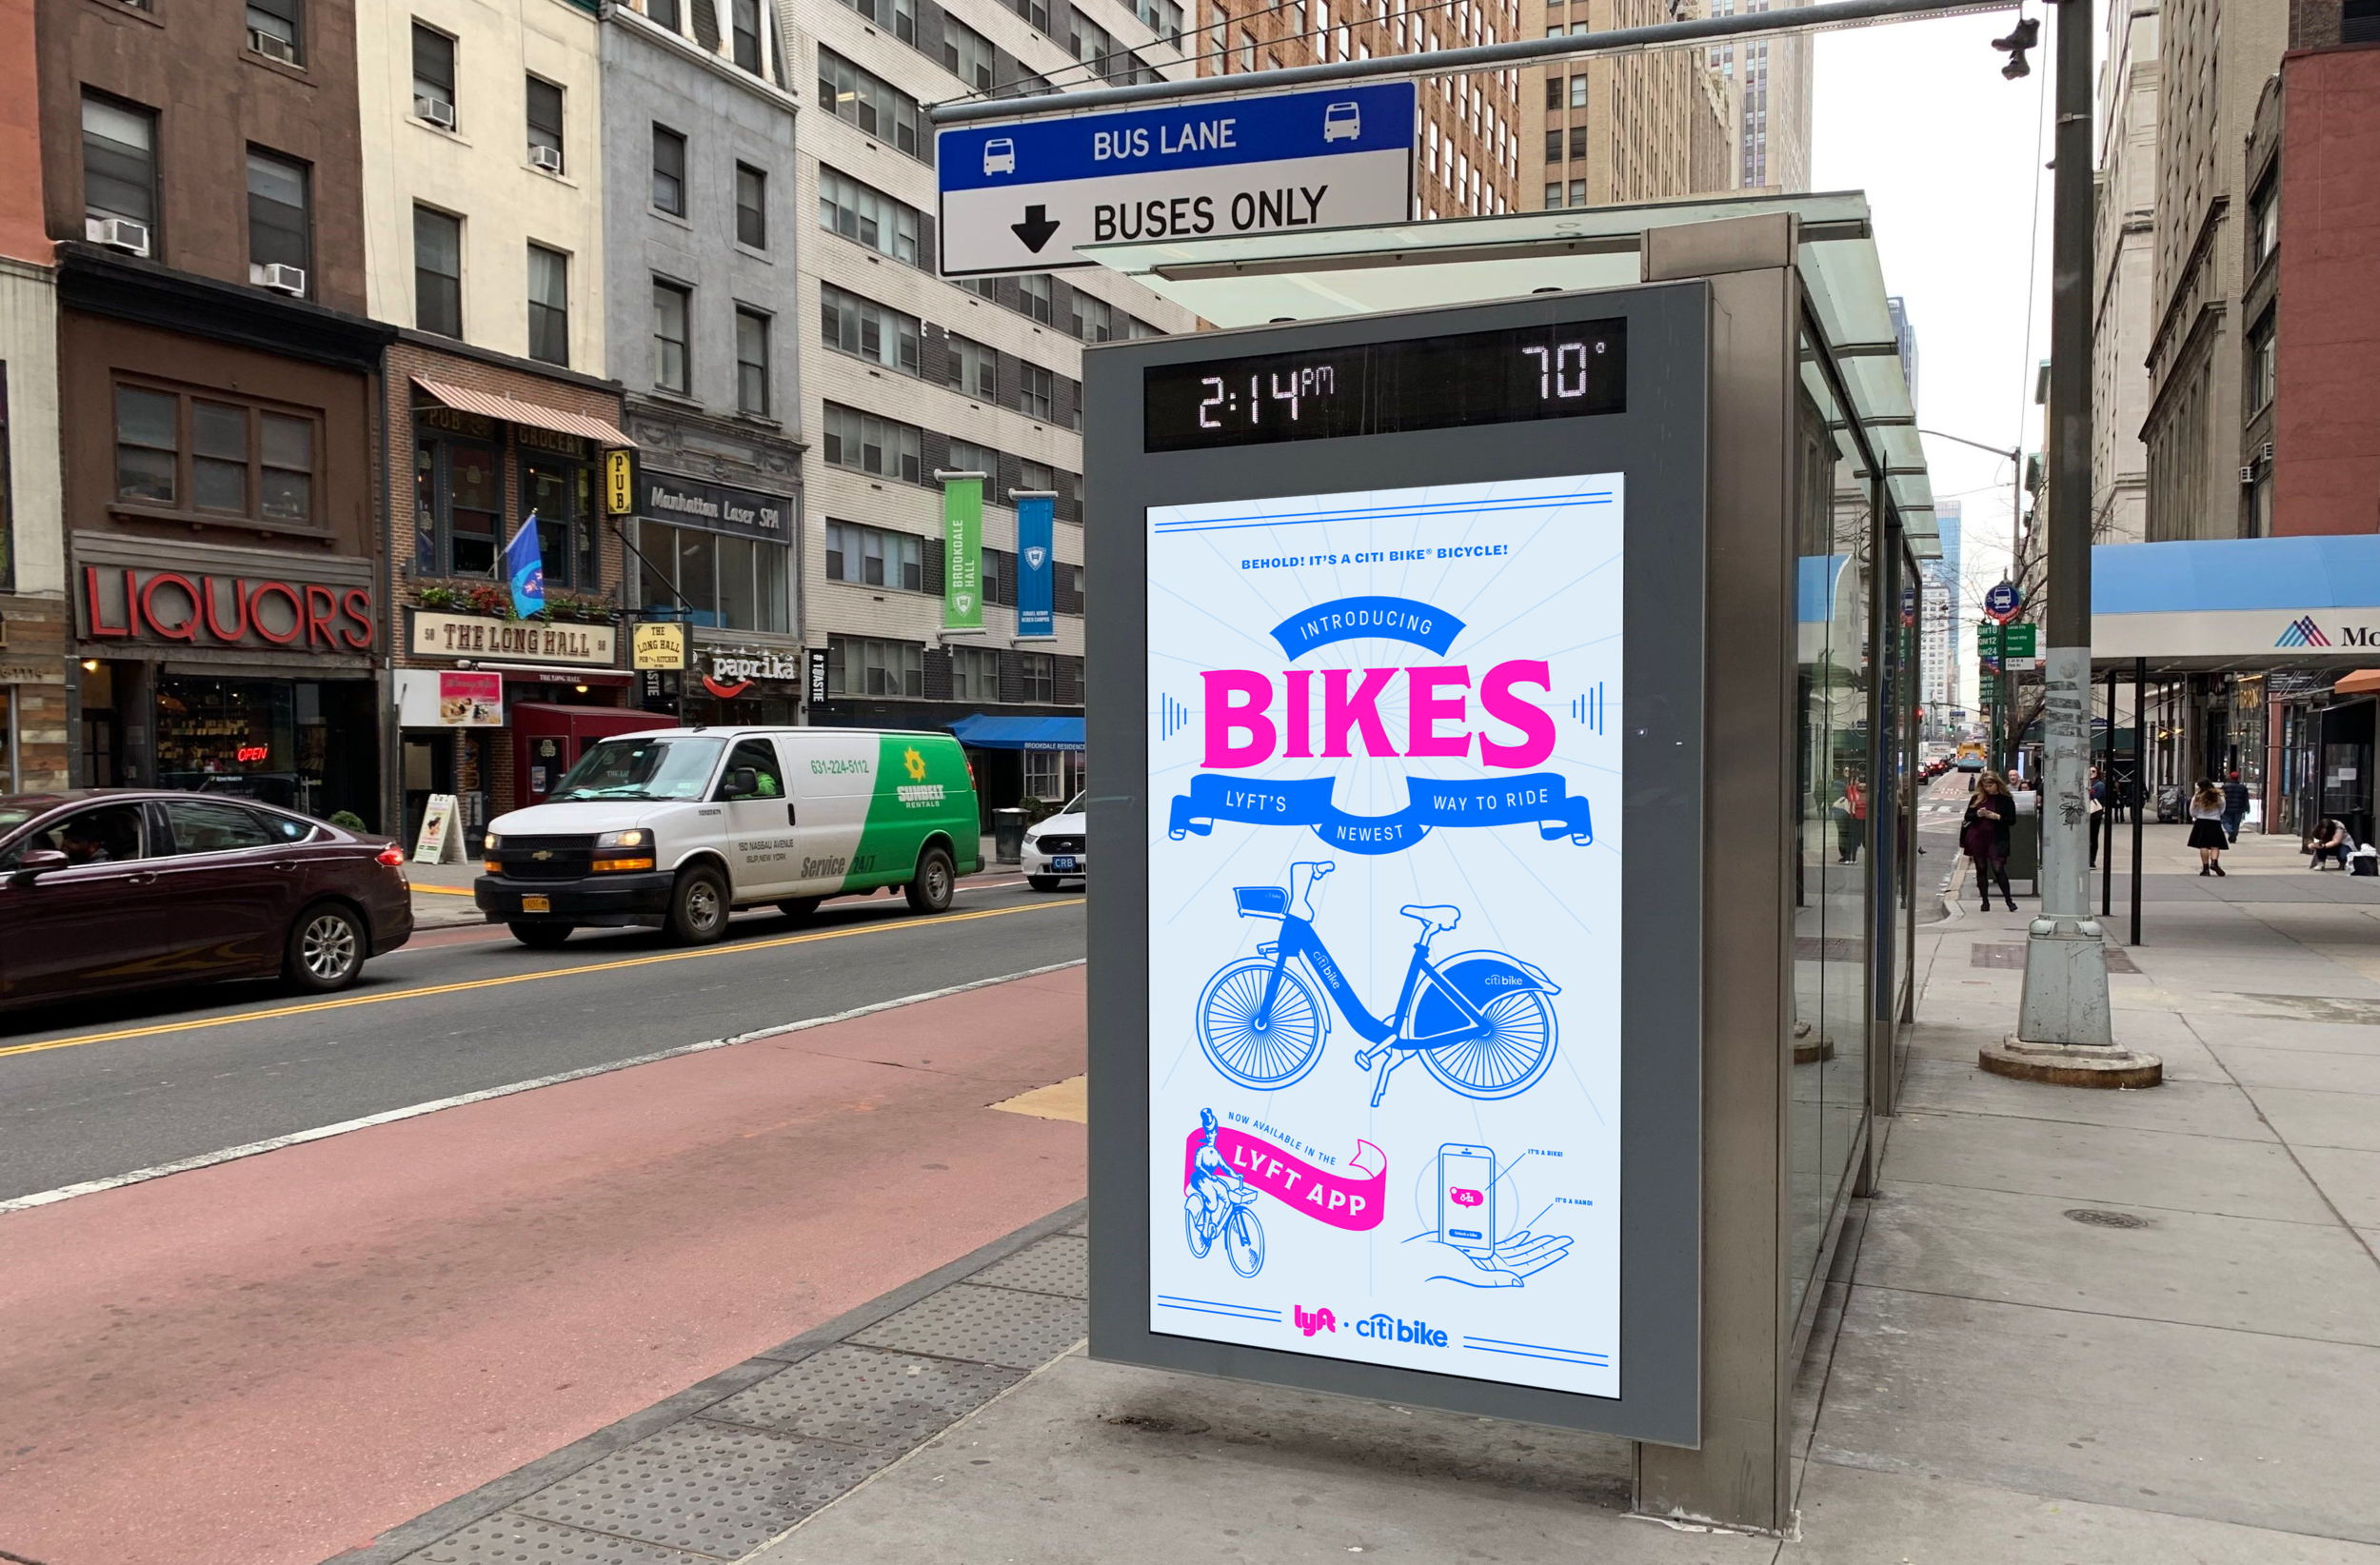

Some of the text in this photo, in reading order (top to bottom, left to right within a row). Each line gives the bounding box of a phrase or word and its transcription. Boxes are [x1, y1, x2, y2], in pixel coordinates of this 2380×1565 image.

[1094, 118, 1237, 161] BUS LANE
[1094, 185, 1329, 242] BUSES ONLY
[1200, 370, 1299, 428] 2:14
[429, 409, 460, 429] PUB
[519, 427, 585, 455] GROCERY
[615, 455, 625, 509] PUB
[650, 485, 780, 529] Manhattan Laser SPA
[952, 520, 963, 588] BROOKDALE
[1241, 556, 1305, 570] BEHOLD!
[1309, 554, 1338, 566] IT'S
[1340, 553, 1351, 565] A
[1355, 551, 1384, 564] CITI
[1437, 545, 1509, 559] BICYCLE!
[964, 560, 975, 587] HALL
[85, 566, 373, 648] LIQUORS
[651, 626, 665, 636] THE
[1299, 609, 1433, 640] INTRODUCING
[1978, 626, 1997, 635] QM10
[2341, 626, 2380, 647] Mo
[444, 624, 590, 657] THE LONG HALL
[637, 639, 680, 654] LONG HALL
[1978, 637, 1997, 645] QM12
[1978, 647, 1997, 656] QM24
[713, 654, 796, 683] paprika
[1200, 659, 1557, 769] BIKES
[238, 747, 268, 762] OPEN
[1024, 742, 1057, 750] BROOKDALE
[810, 759, 870, 775] 631-224-5112
[897, 784, 945, 802] SUNBELT
[1226, 789, 1286, 812] LYFT'S
[1434, 788, 1549, 811] WAY TO RIDE
[1337, 824, 1403, 842] NEWEST
[738, 839, 794, 852] 150 NASSAU AVENUE
[771, 852, 787, 862] YORK
[801, 855, 876, 879] Service 24/7
[1054, 858, 1074, 868] CRB
[1228, 1111, 1338, 1166] NOW AVAILABLE IN THE
[1233, 1144, 1366, 1217] LYFT APP
[1294, 1304, 1336, 1337] lyft
